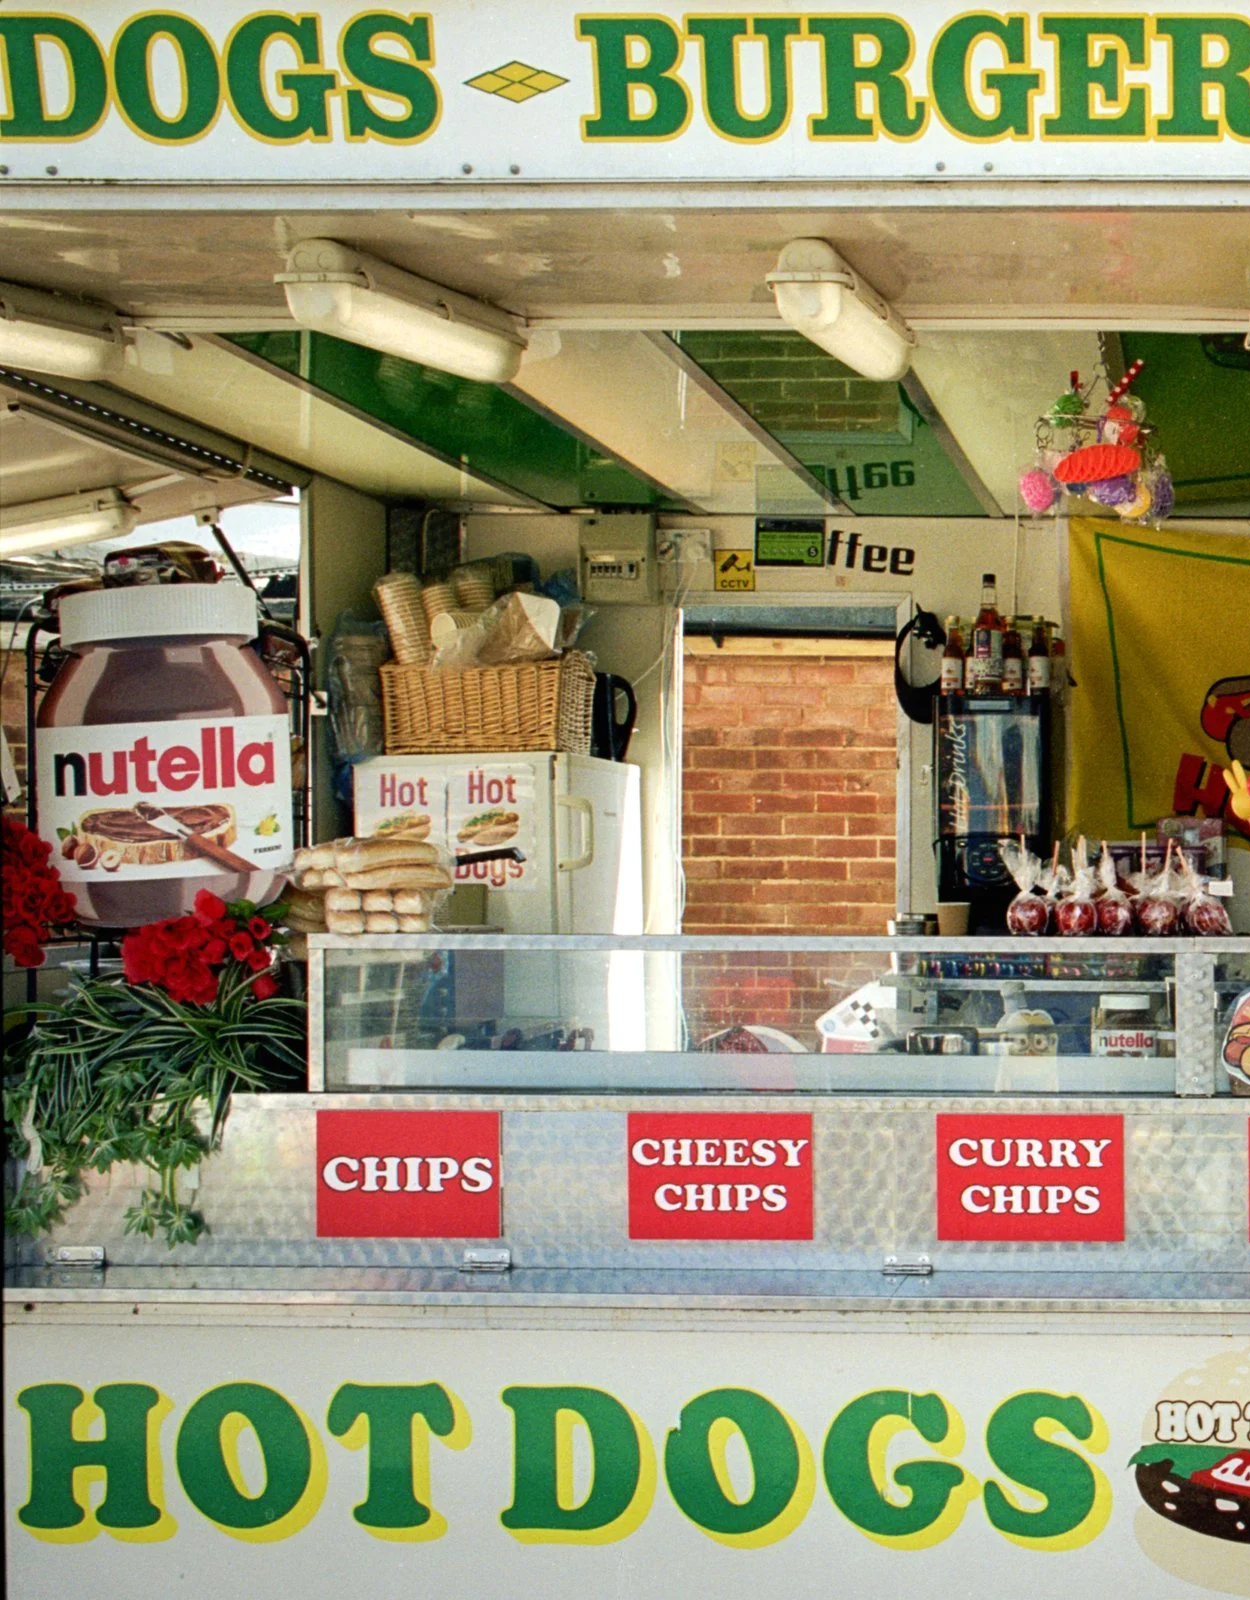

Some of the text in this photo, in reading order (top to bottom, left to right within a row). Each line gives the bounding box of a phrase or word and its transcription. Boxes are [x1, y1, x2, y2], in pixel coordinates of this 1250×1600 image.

[0, 8, 444, 147] DOGS
[827, 529, 915, 576] ffee
[720, 579, 750, 588] CCTV
[53, 726, 275, 797] nutella
[945, 722, 967, 788] Drinks
[380, 772, 428, 807] Hot
[468, 769, 517, 804] Hot
[1098, 1031, 1154, 1048] nutella
[633, 1138, 808, 1167] CHEESY
[949, 1138, 1111, 1168] CURRY
[322, 1156, 493, 1193] CHIPS
[654, 1183, 787, 1212] CHIPS
[961, 1185, 1100, 1215] CHIPS
[1156, 1400, 1242, 1443] HOT
[17, 1380, 1112, 1554] HOT DOGS
